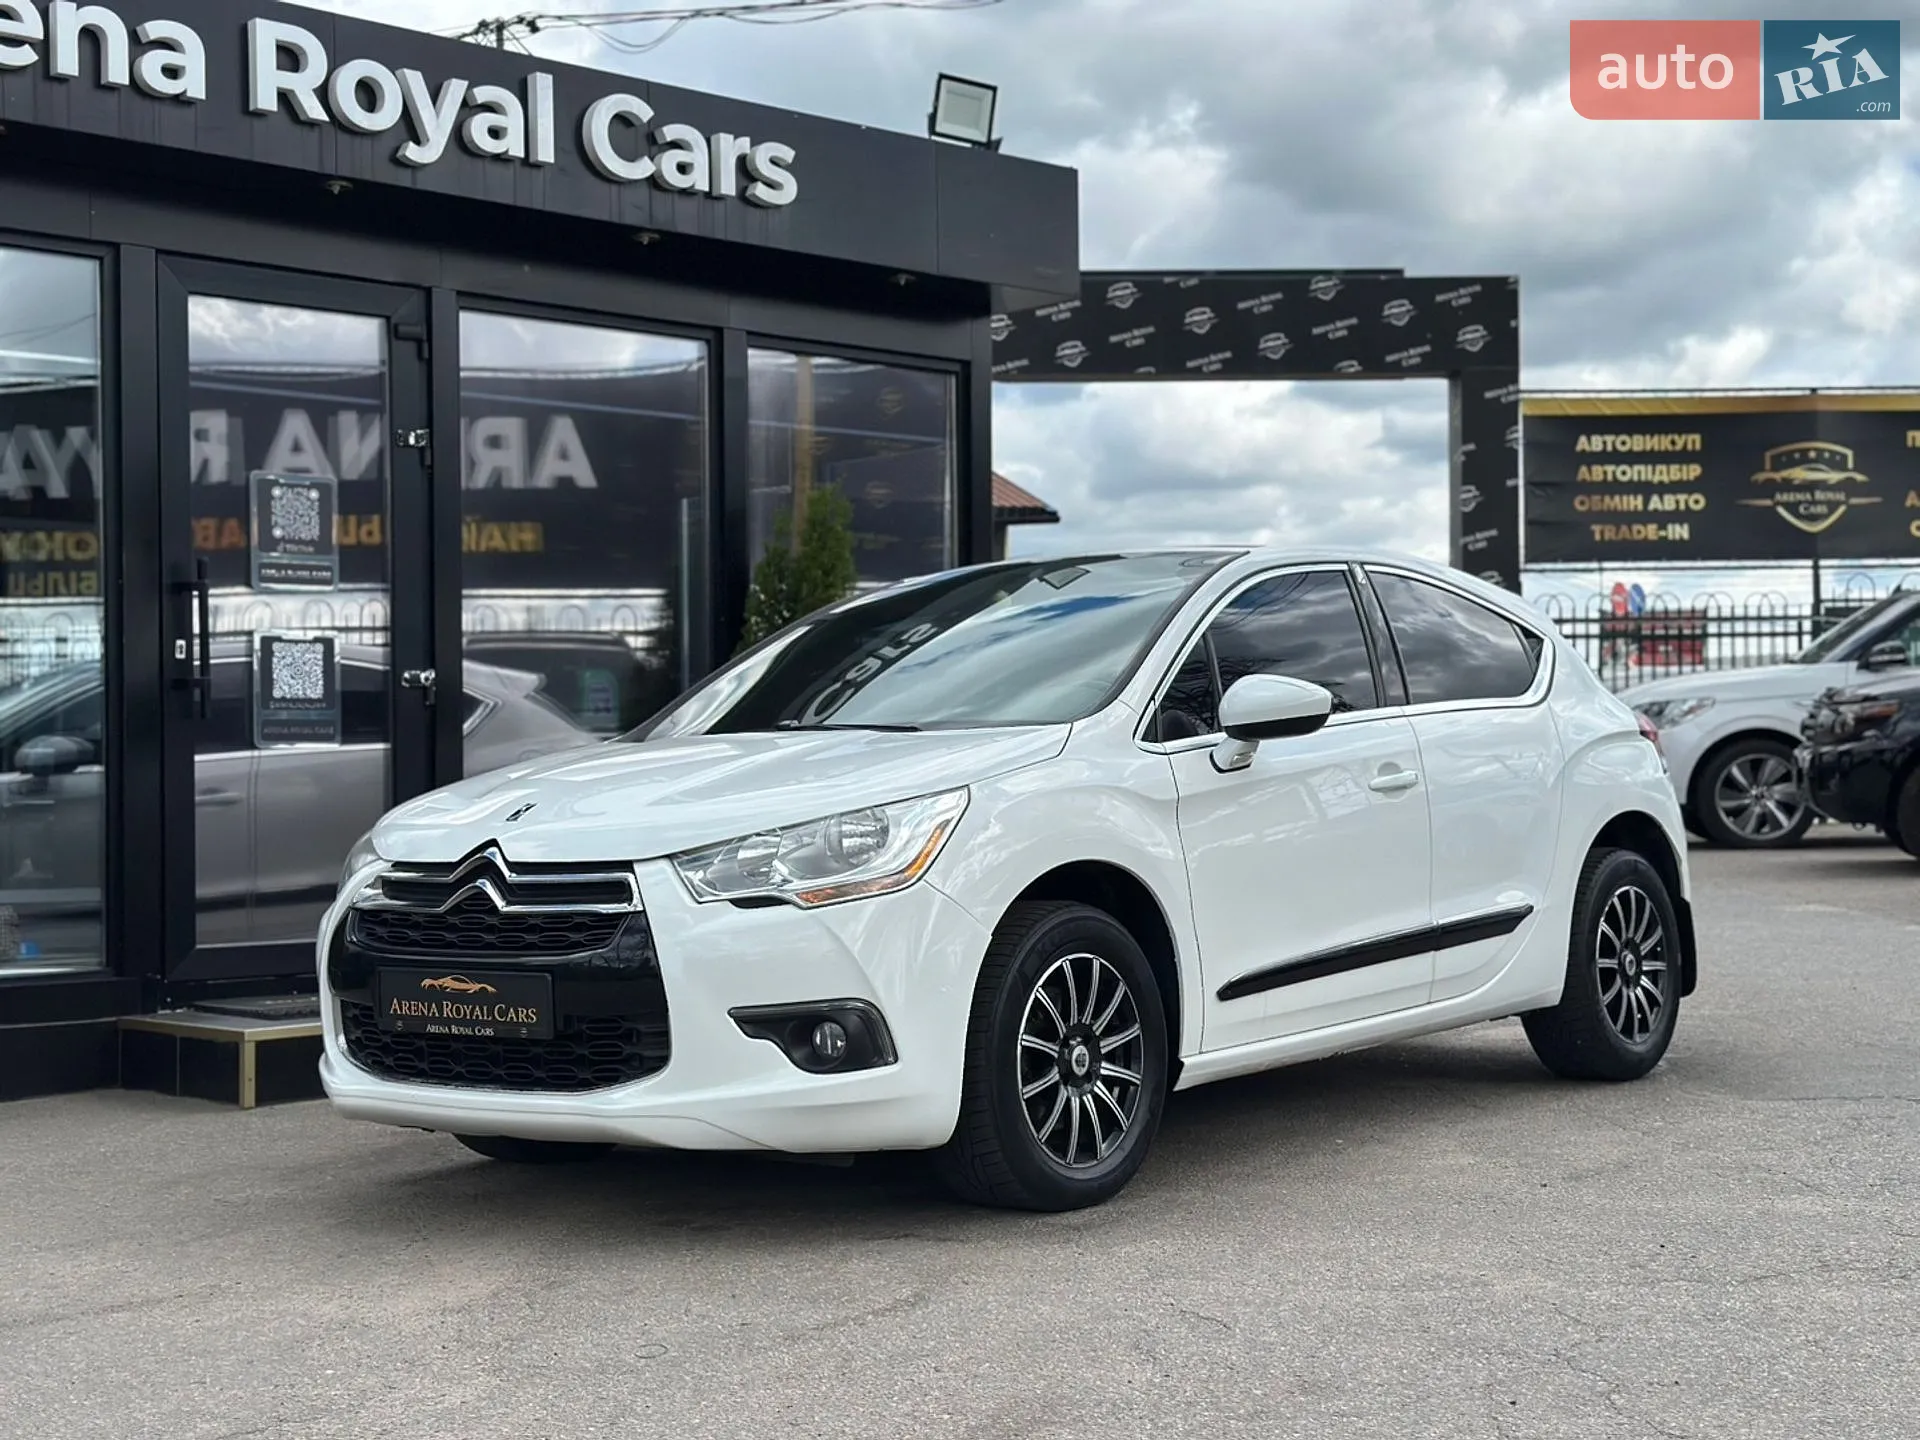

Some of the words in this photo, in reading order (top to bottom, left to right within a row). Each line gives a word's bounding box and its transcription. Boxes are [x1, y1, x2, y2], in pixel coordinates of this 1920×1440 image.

[247, 17, 555, 167] Royal
[582, 92, 799, 207] Cars
[1576, 433, 1701, 453] АВТОВИКУП
[1576, 464, 1702, 484] АВТОПІДБІР
[1574, 494, 1644, 513] ОБМІН
[1647, 493, 1706, 512] АВТО
[1591, 523, 1690, 541] TRADE-IN
[390, 998, 439, 1017] ARENA
[443, 1001, 493, 1021] ROYAL
[494, 1004, 537, 1023] CARS
